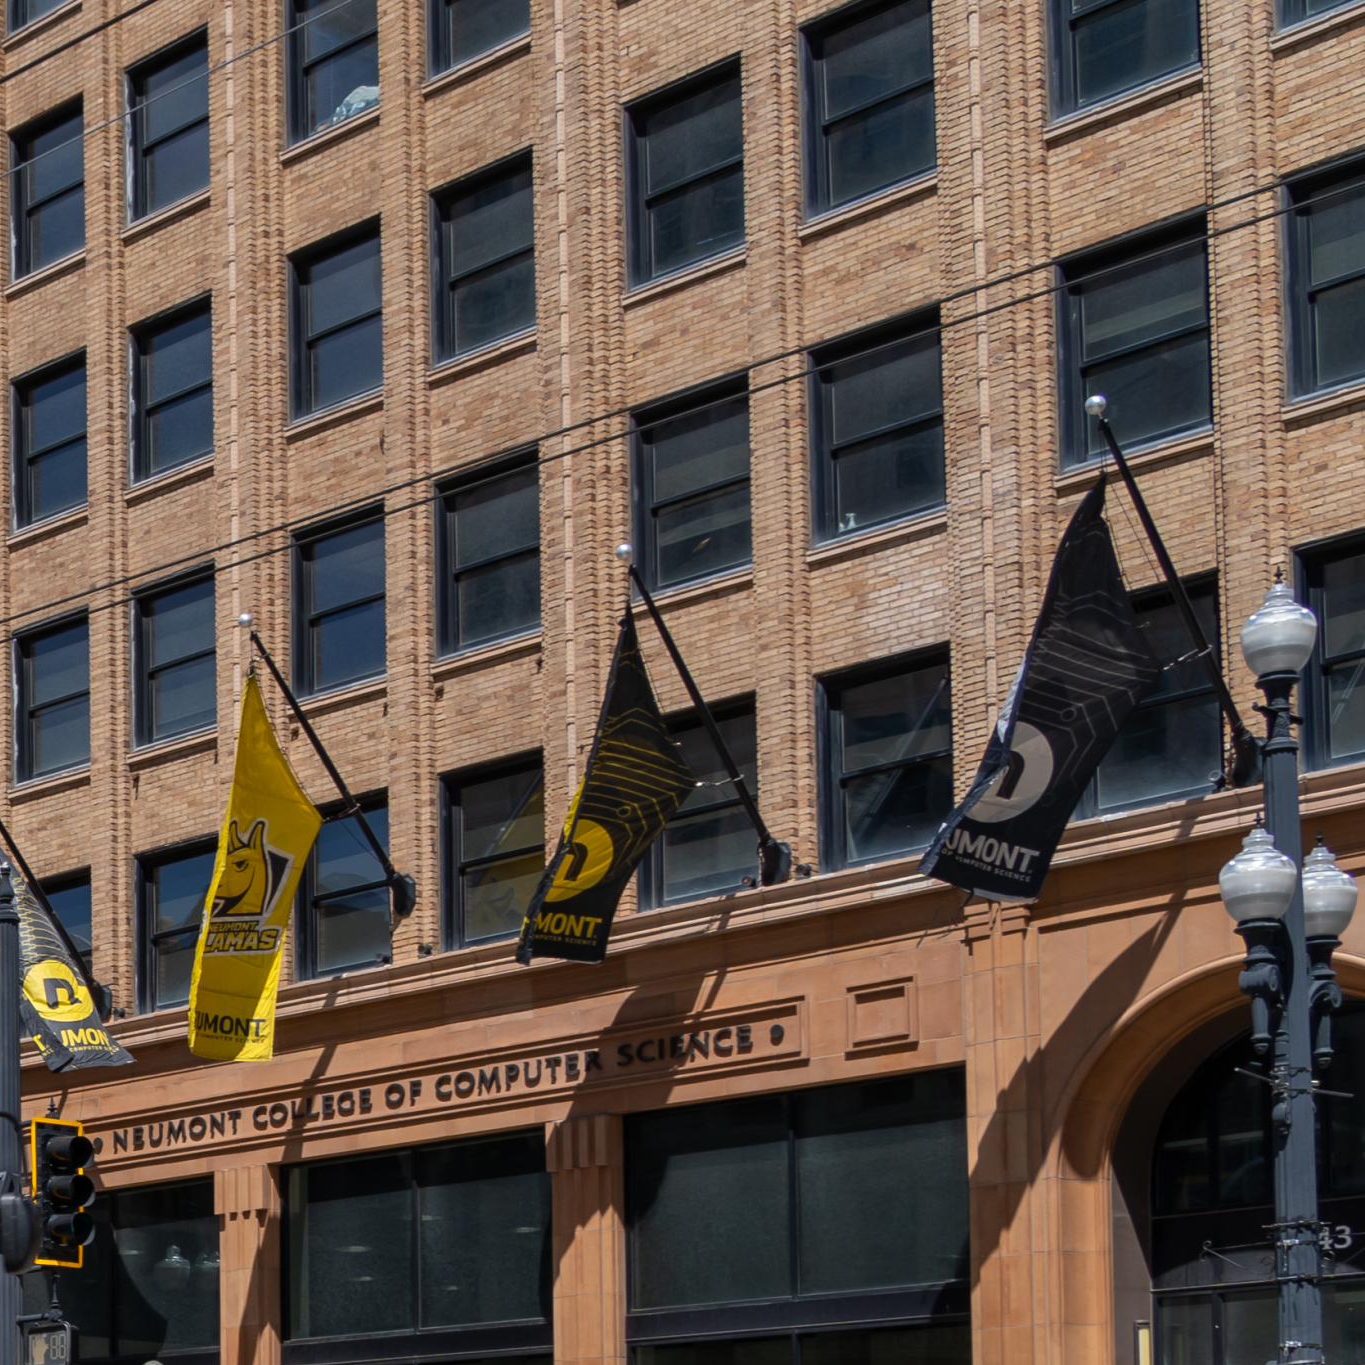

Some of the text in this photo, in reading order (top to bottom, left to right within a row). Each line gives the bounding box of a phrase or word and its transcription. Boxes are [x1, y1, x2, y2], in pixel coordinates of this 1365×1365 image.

[994, 867, 1032, 882] SCIENCE
[565, 937, 598, 947] SCIENCE
[195, 1010, 266, 1038] UMONT
[113, 1025, 754, 1153] NEUMONT COLLEGE OF COMPUTER SCIENCE
